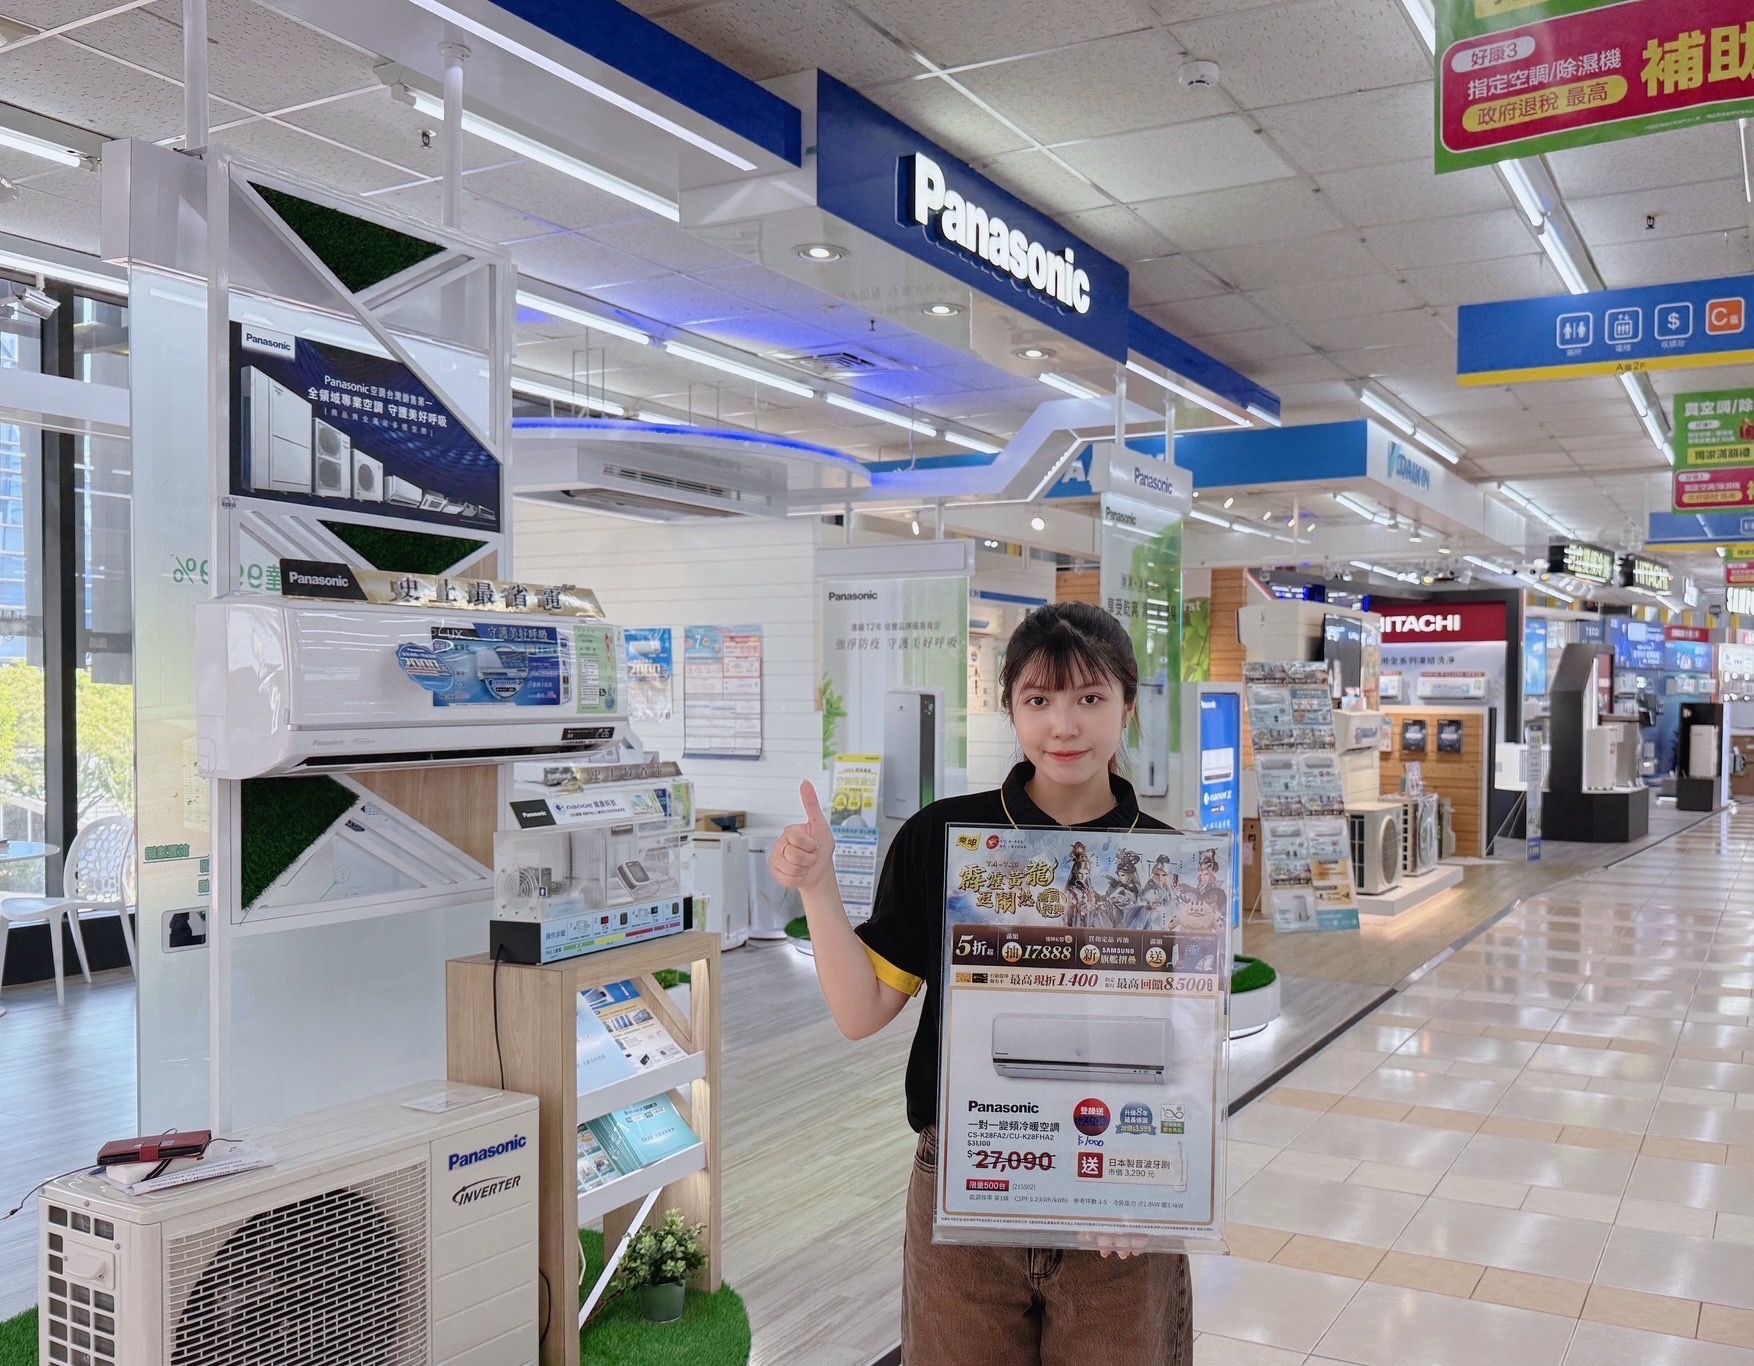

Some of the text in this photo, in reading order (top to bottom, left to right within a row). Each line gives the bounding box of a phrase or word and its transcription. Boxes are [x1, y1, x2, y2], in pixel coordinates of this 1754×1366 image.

[1471, 43, 1518, 67] 好康3
[1467, 47, 1622, 101] 指定空調/除濕機
[1478, 82, 1608, 126] 政府退稅 最高
[915, 151, 1090, 314] Panasonic
[246, 332, 292, 351] Panasonic
[307, 387, 448, 428] 全領域專業空調 守護美好呼吸
[1134, 467, 1173, 495] Panasonic
[1395, 454, 1431, 491] DAIKIN
[1105, 506, 1137, 526] Panasonic
[289, 571, 349, 588] Panasonic
[398, 575, 564, 610] 史上最省電
[828, 590, 878, 601] Panasonic
[1379, 614, 1461, 633] ITACHI
[1585, 626, 1599, 637] TECO
[958, 857, 1059, 893] 霹靂黃龍
[1101, 947, 1135, 955] SAMSUNG
[968, 1100, 1040, 1114] Panasonic
[1079, 1106, 1105, 1116] 登錄送
[1124, 1107, 1149, 1117] 升級8年
[967, 1119, 1060, 1133] 一對一變頻冷暖空調
[967, 1131, 1055, 1142] CS-K28FA2/CU-K28FHA2
[448, 1134, 527, 1171] Panasonic
[1081, 1156, 1099, 1175] 送
[1108, 1168, 1155, 1178] 市價 3,290 元
[1109, 1157, 1171, 1170] 日本製音波牙刷
[457, 1175, 521, 1207] INVERTER
[968, 1181, 1006, 1190] 限量500台
